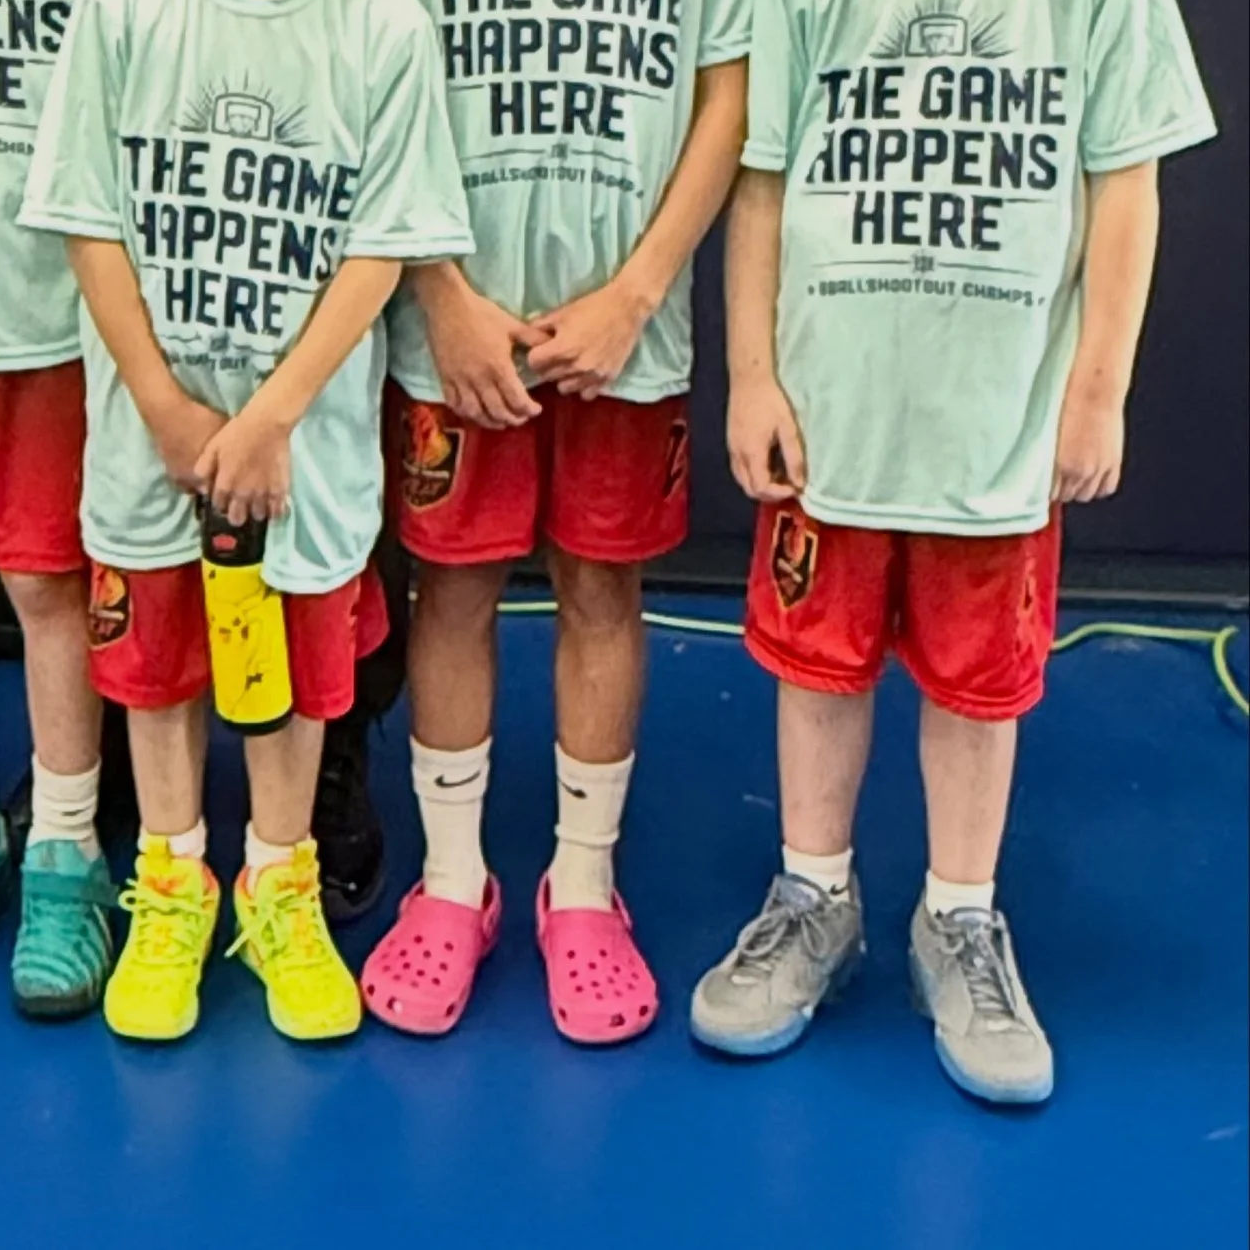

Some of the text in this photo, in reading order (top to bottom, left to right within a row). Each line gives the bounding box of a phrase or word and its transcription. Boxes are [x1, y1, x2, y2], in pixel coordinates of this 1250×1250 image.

[441, 18, 677, 90] HAPPENS
[488, 81, 626, 142] HERE
[817, 66, 1067, 125] THE GAME
[121, 137, 359, 221] THE GAME
[805, 128, 1058, 190] HAPPENS
[132, 201, 338, 282] HAPPENS
[852, 191, 1003, 251] HERE
[164, 267, 289, 339] HERE
